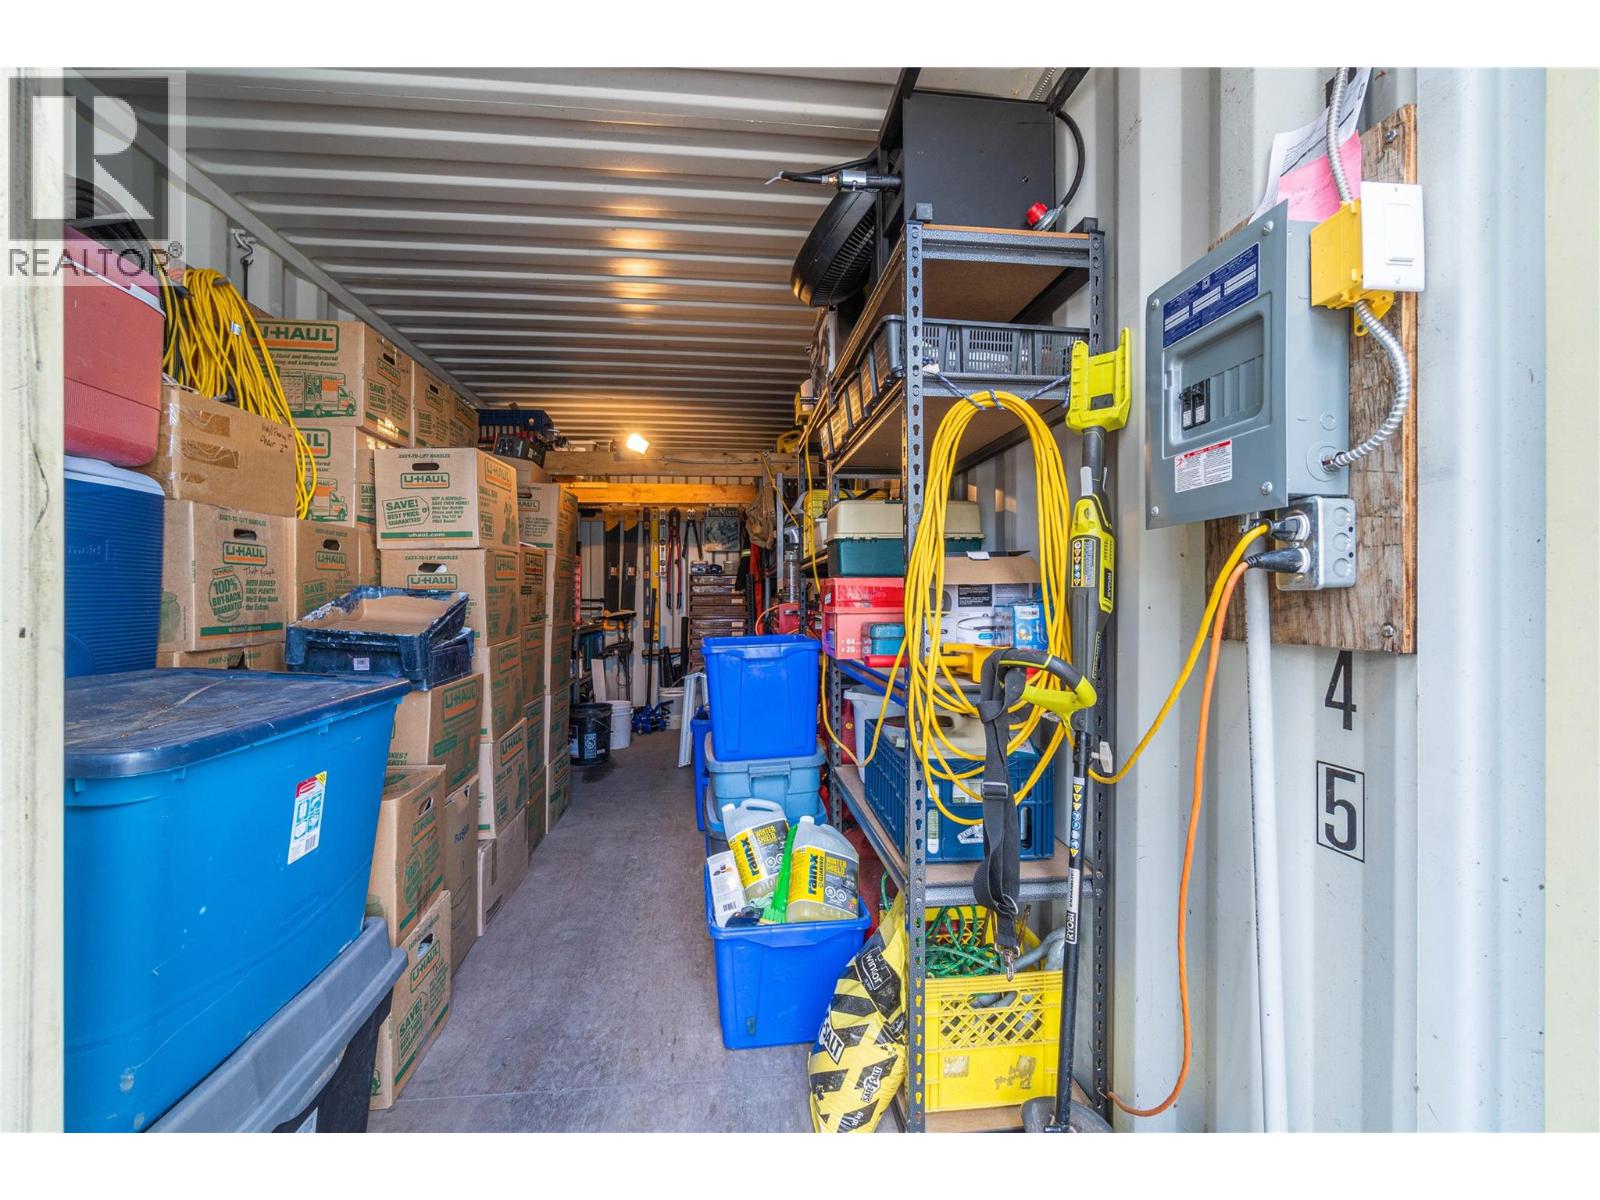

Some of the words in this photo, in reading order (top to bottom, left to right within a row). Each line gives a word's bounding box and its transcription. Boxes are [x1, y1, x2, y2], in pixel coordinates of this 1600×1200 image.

[250, 326, 333, 341] U-HAUL
[403, 475, 447, 483] U-HAUL
[386, 499, 419, 511] SAVE!
[402, 510, 419, 518] PRICE
[226, 545, 265, 558] U-HAUL
[317, 554, 345, 564] U-HAUL
[213, 578, 238, 595] 100%
[411, 576, 454, 584] U-HAUL
[212, 592, 241, 607] BUY-BACK
[445, 686, 477, 708] U-HAUL
[1325, 651, 1357, 731] 4
[1325, 767, 1357, 851] 5
[1066, 912, 1075, 941] RYOBI
[412, 945, 439, 981] U-HAUL
[822, 1021, 844, 1056] SALT
